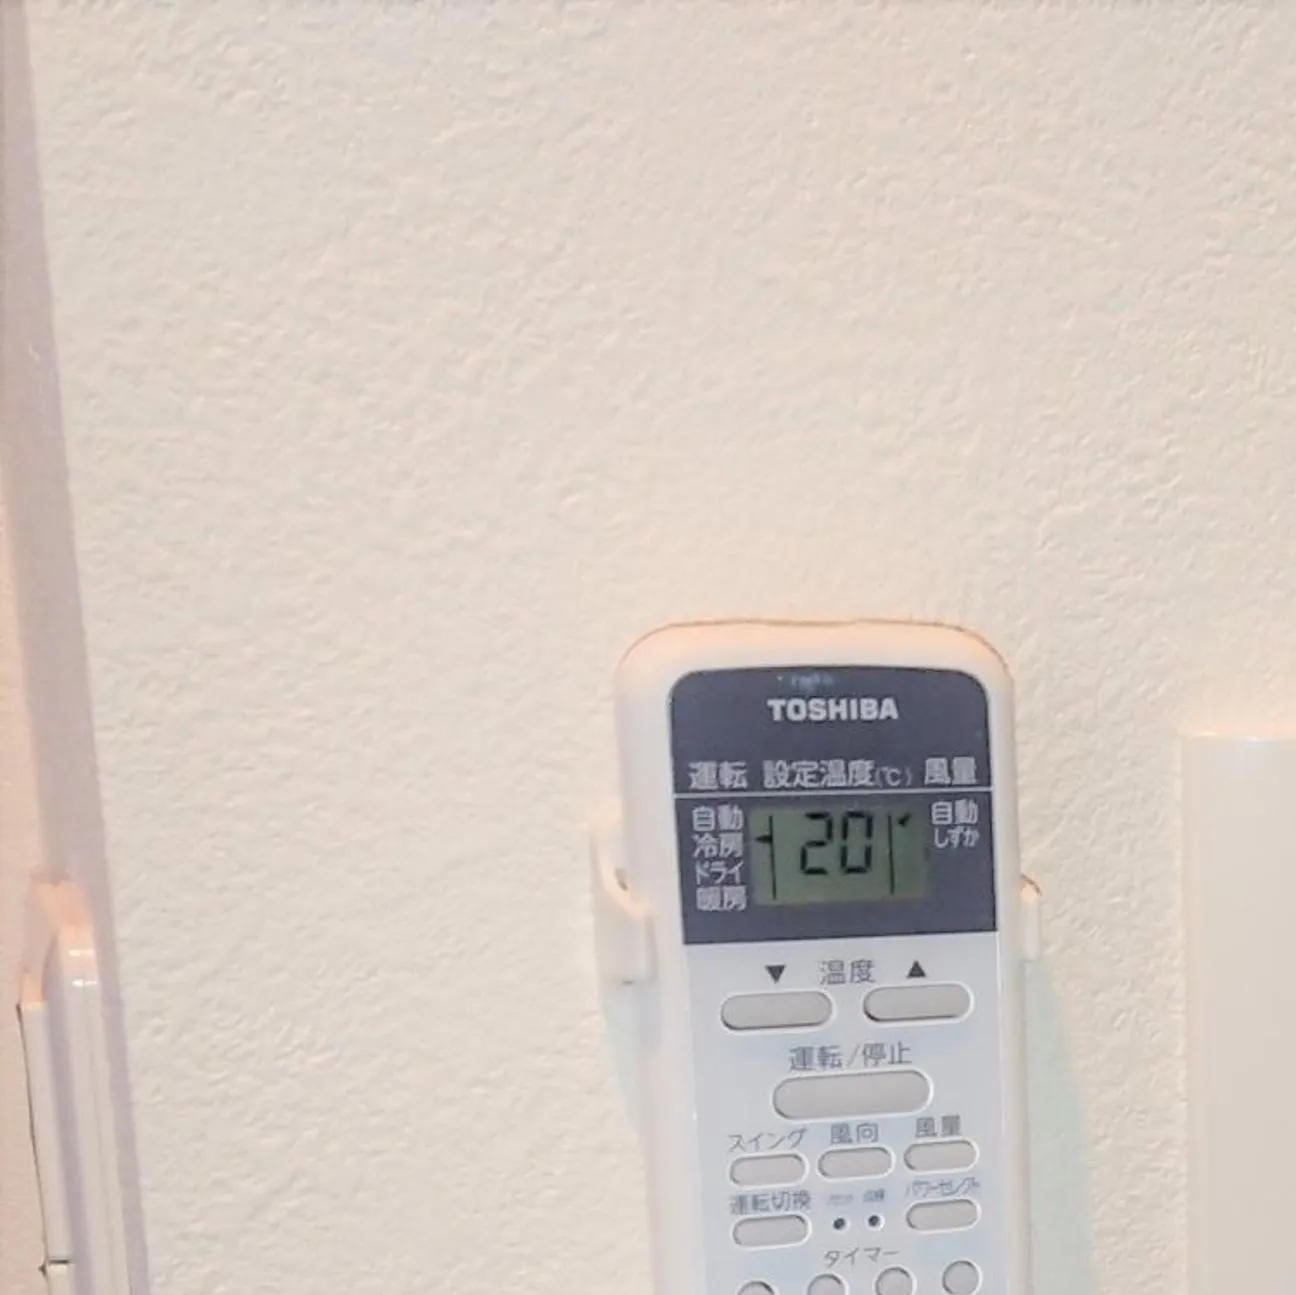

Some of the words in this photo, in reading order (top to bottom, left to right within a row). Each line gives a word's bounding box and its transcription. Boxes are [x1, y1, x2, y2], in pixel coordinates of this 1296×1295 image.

[767, 698, 898, 721] TOSHIBA
[688, 761, 748, 790] 運転
[924, 757, 977, 785] 風量
[692, 805, 744, 831] 自動
[931, 800, 978, 826] 自動
[693, 833, 743, 858] 冷房
[800, 811, 873, 875] 20
[934, 827, 980, 849] しずか
[695, 860, 744, 885] ドライ
[696, 886, 747, 911] 暖房
[819, 959, 875, 985] 温度
[789, 1041, 912, 1071] 運転/停止
[728, 1127, 808, 1151] スイング
[830, 1122, 879, 1144] 風向
[824, 1247, 900, 1268] タイマー
